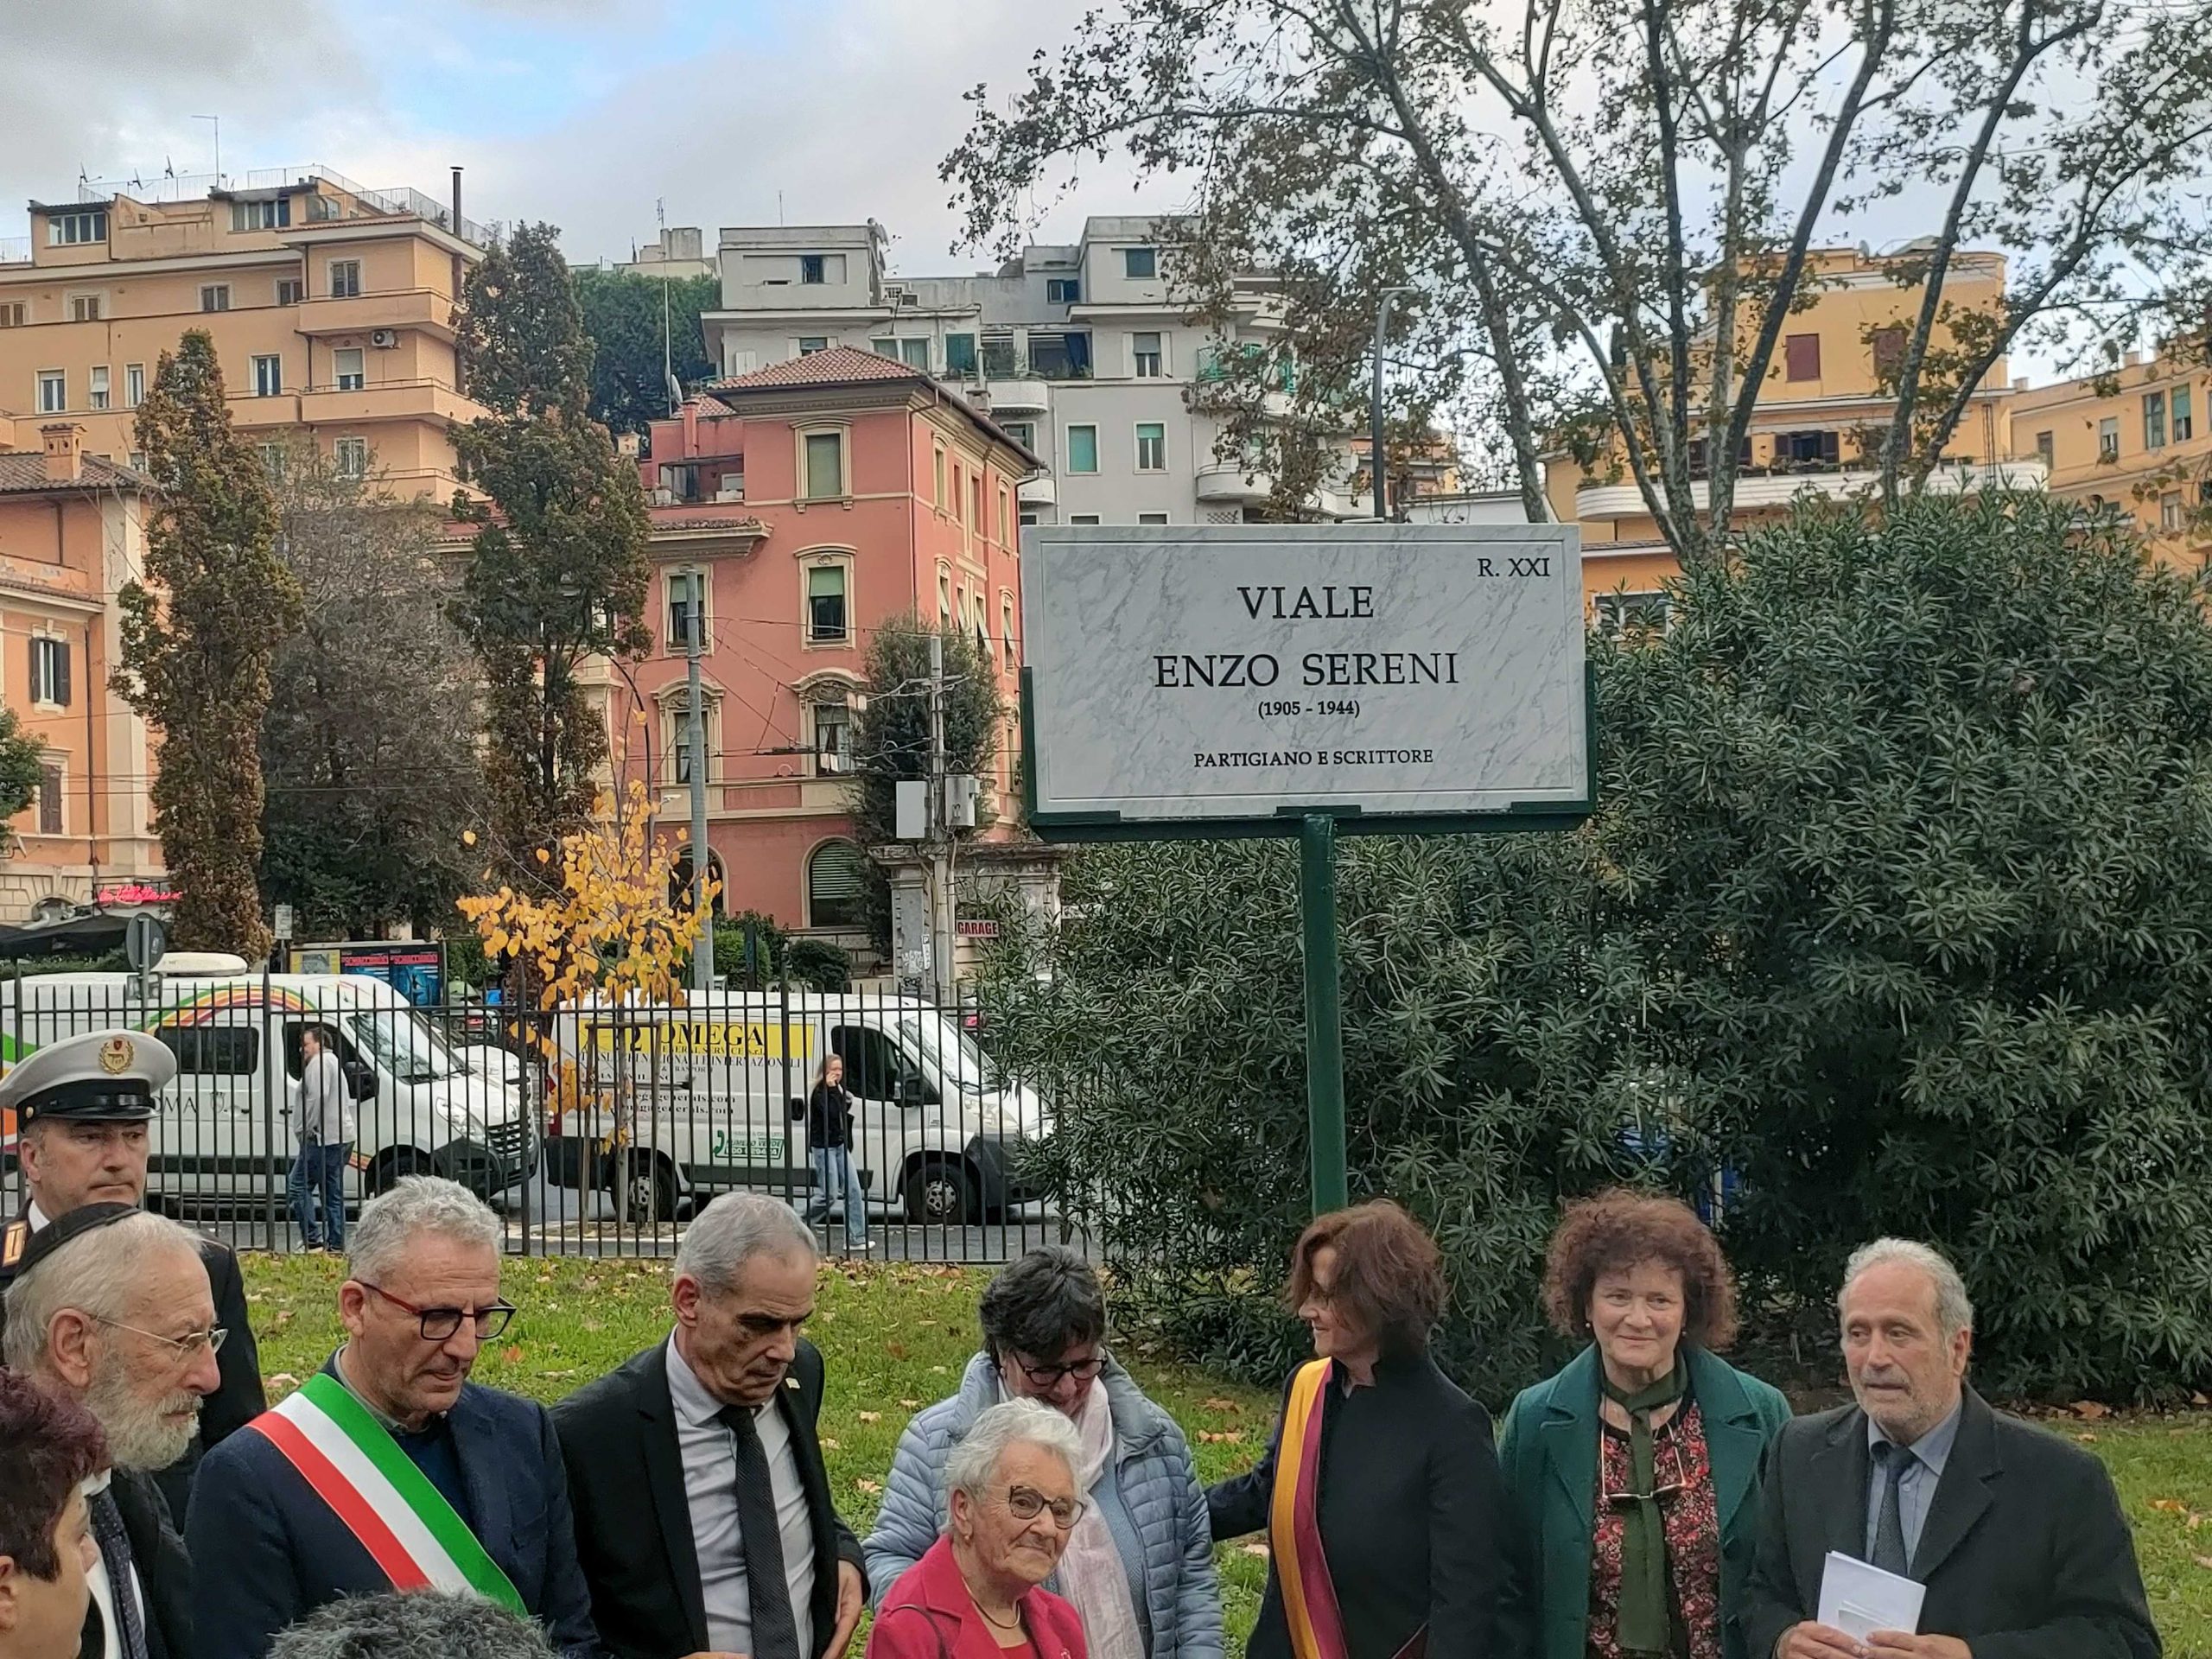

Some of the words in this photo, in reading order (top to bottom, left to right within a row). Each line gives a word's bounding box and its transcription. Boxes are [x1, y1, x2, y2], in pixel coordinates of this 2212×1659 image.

[1477, 557, 1500, 577] R.
[1508, 557, 1551, 577] XXI
[1237, 586, 1374, 620] VIALE
[1154, 653, 1280, 688] ENZO
[1302, 652, 1460, 686] SERENI
[1258, 701, 1301, 720] (1905
[1317, 700, 1360, 719] 1944)
[1194, 751, 1313, 767] PARTIGIANO
[1318, 751, 1329, 766] E
[1333, 749, 1433, 765] SCRITTORE
[957, 921, 998, 935] GARAGE
[657, 1023, 764, 1046] OMEGA
